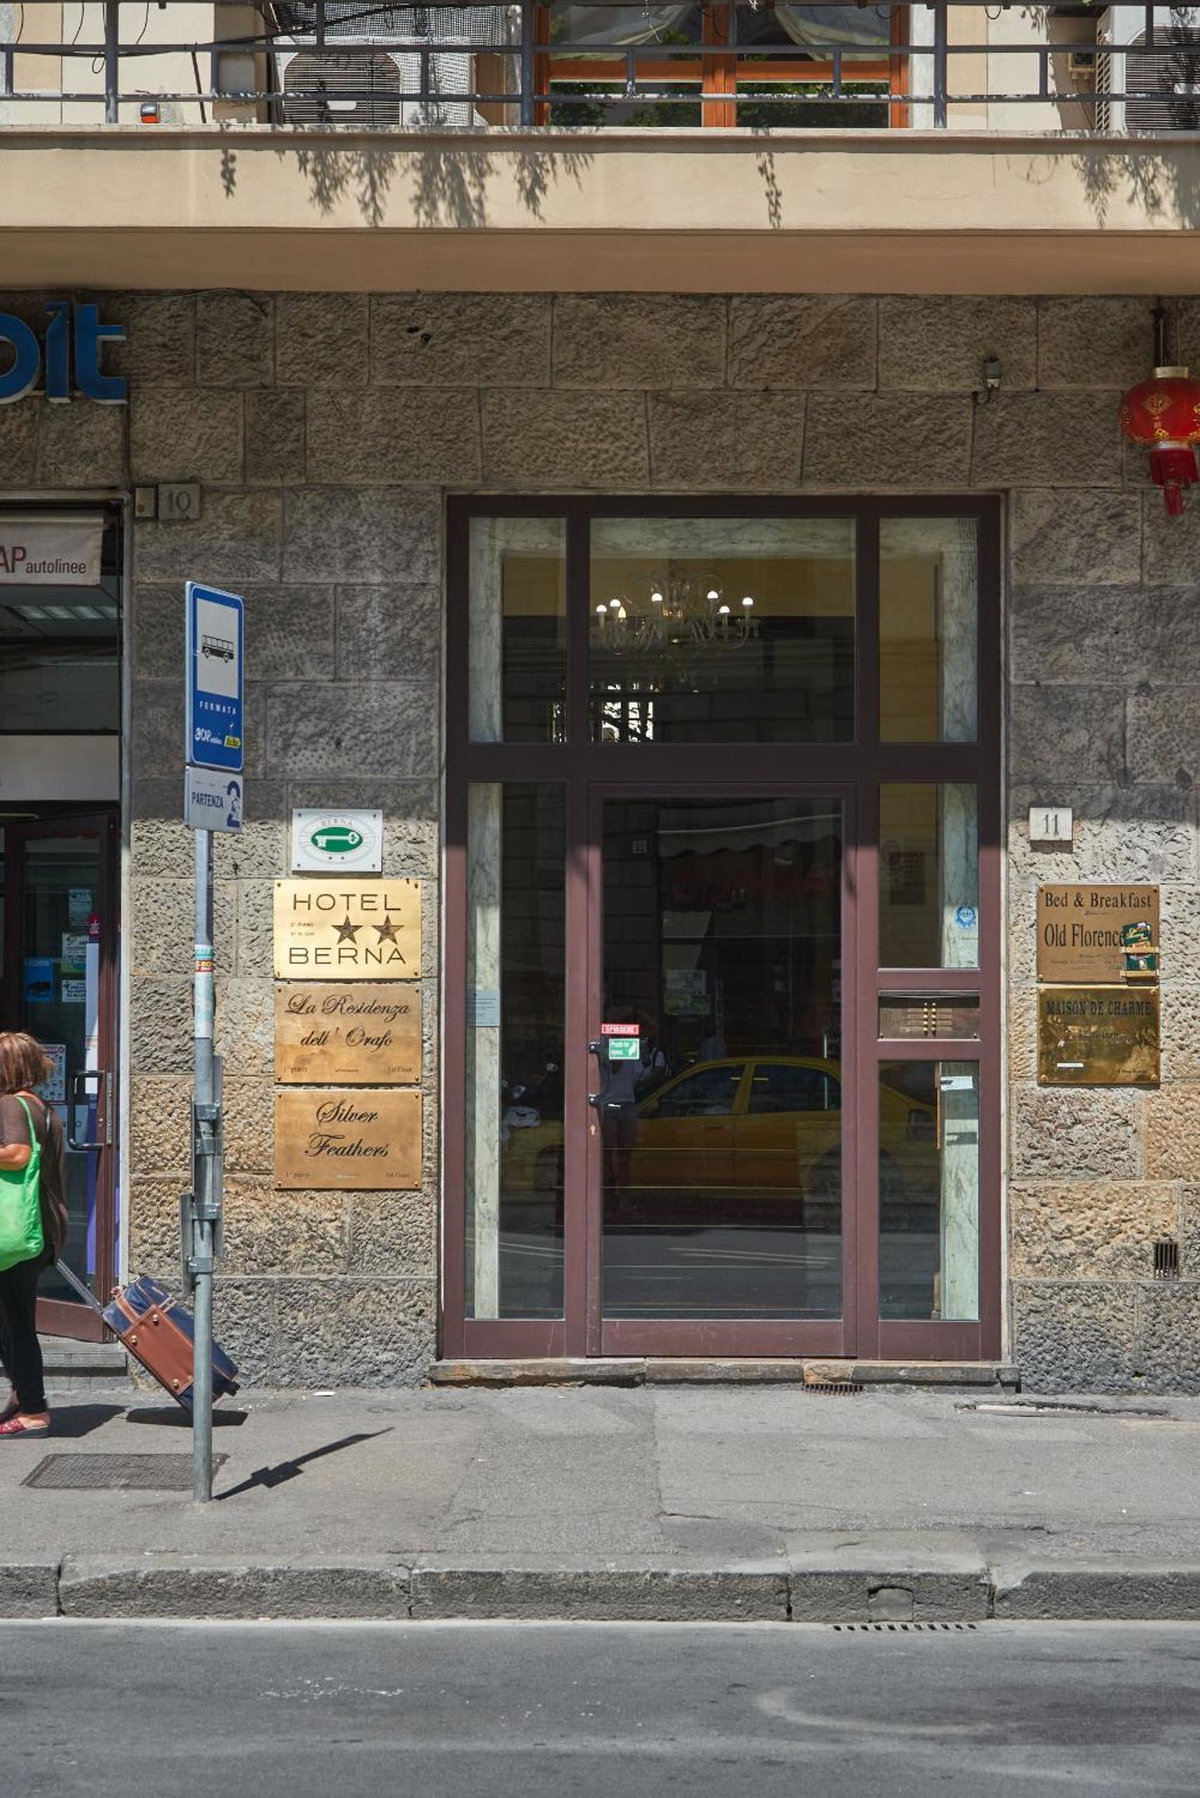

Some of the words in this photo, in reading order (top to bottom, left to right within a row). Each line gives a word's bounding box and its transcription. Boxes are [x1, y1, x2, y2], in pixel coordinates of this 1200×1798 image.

[167, 491, 191, 510] 10
[26, 558, 87, 574] autolinee
[199, 701, 237, 715] FERMATA
[191, 791, 224, 810] PARTENZA
[1044, 814, 1060, 836] 11
[293, 893, 402, 911] HOTEL
[1045, 892, 1068, 908] Bed
[1073, 893, 1085, 908] &
[1090, 892, 1152, 908] Breakfast
[1044, 923, 1066, 948] Old
[289, 947, 407, 965] BERNA
[285, 993, 316, 1015] La
[321, 994, 410, 1023] Residenza
[1046, 1000, 1086, 1016] MAISON
[1090, 1000, 1104, 1016] DE
[1108, 1000, 1151, 1016] CHARME
[346, 1025, 393, 1053] Orafo
[316, 1100, 379, 1127] Silver
[304, 1132, 390, 1158] Feathers
